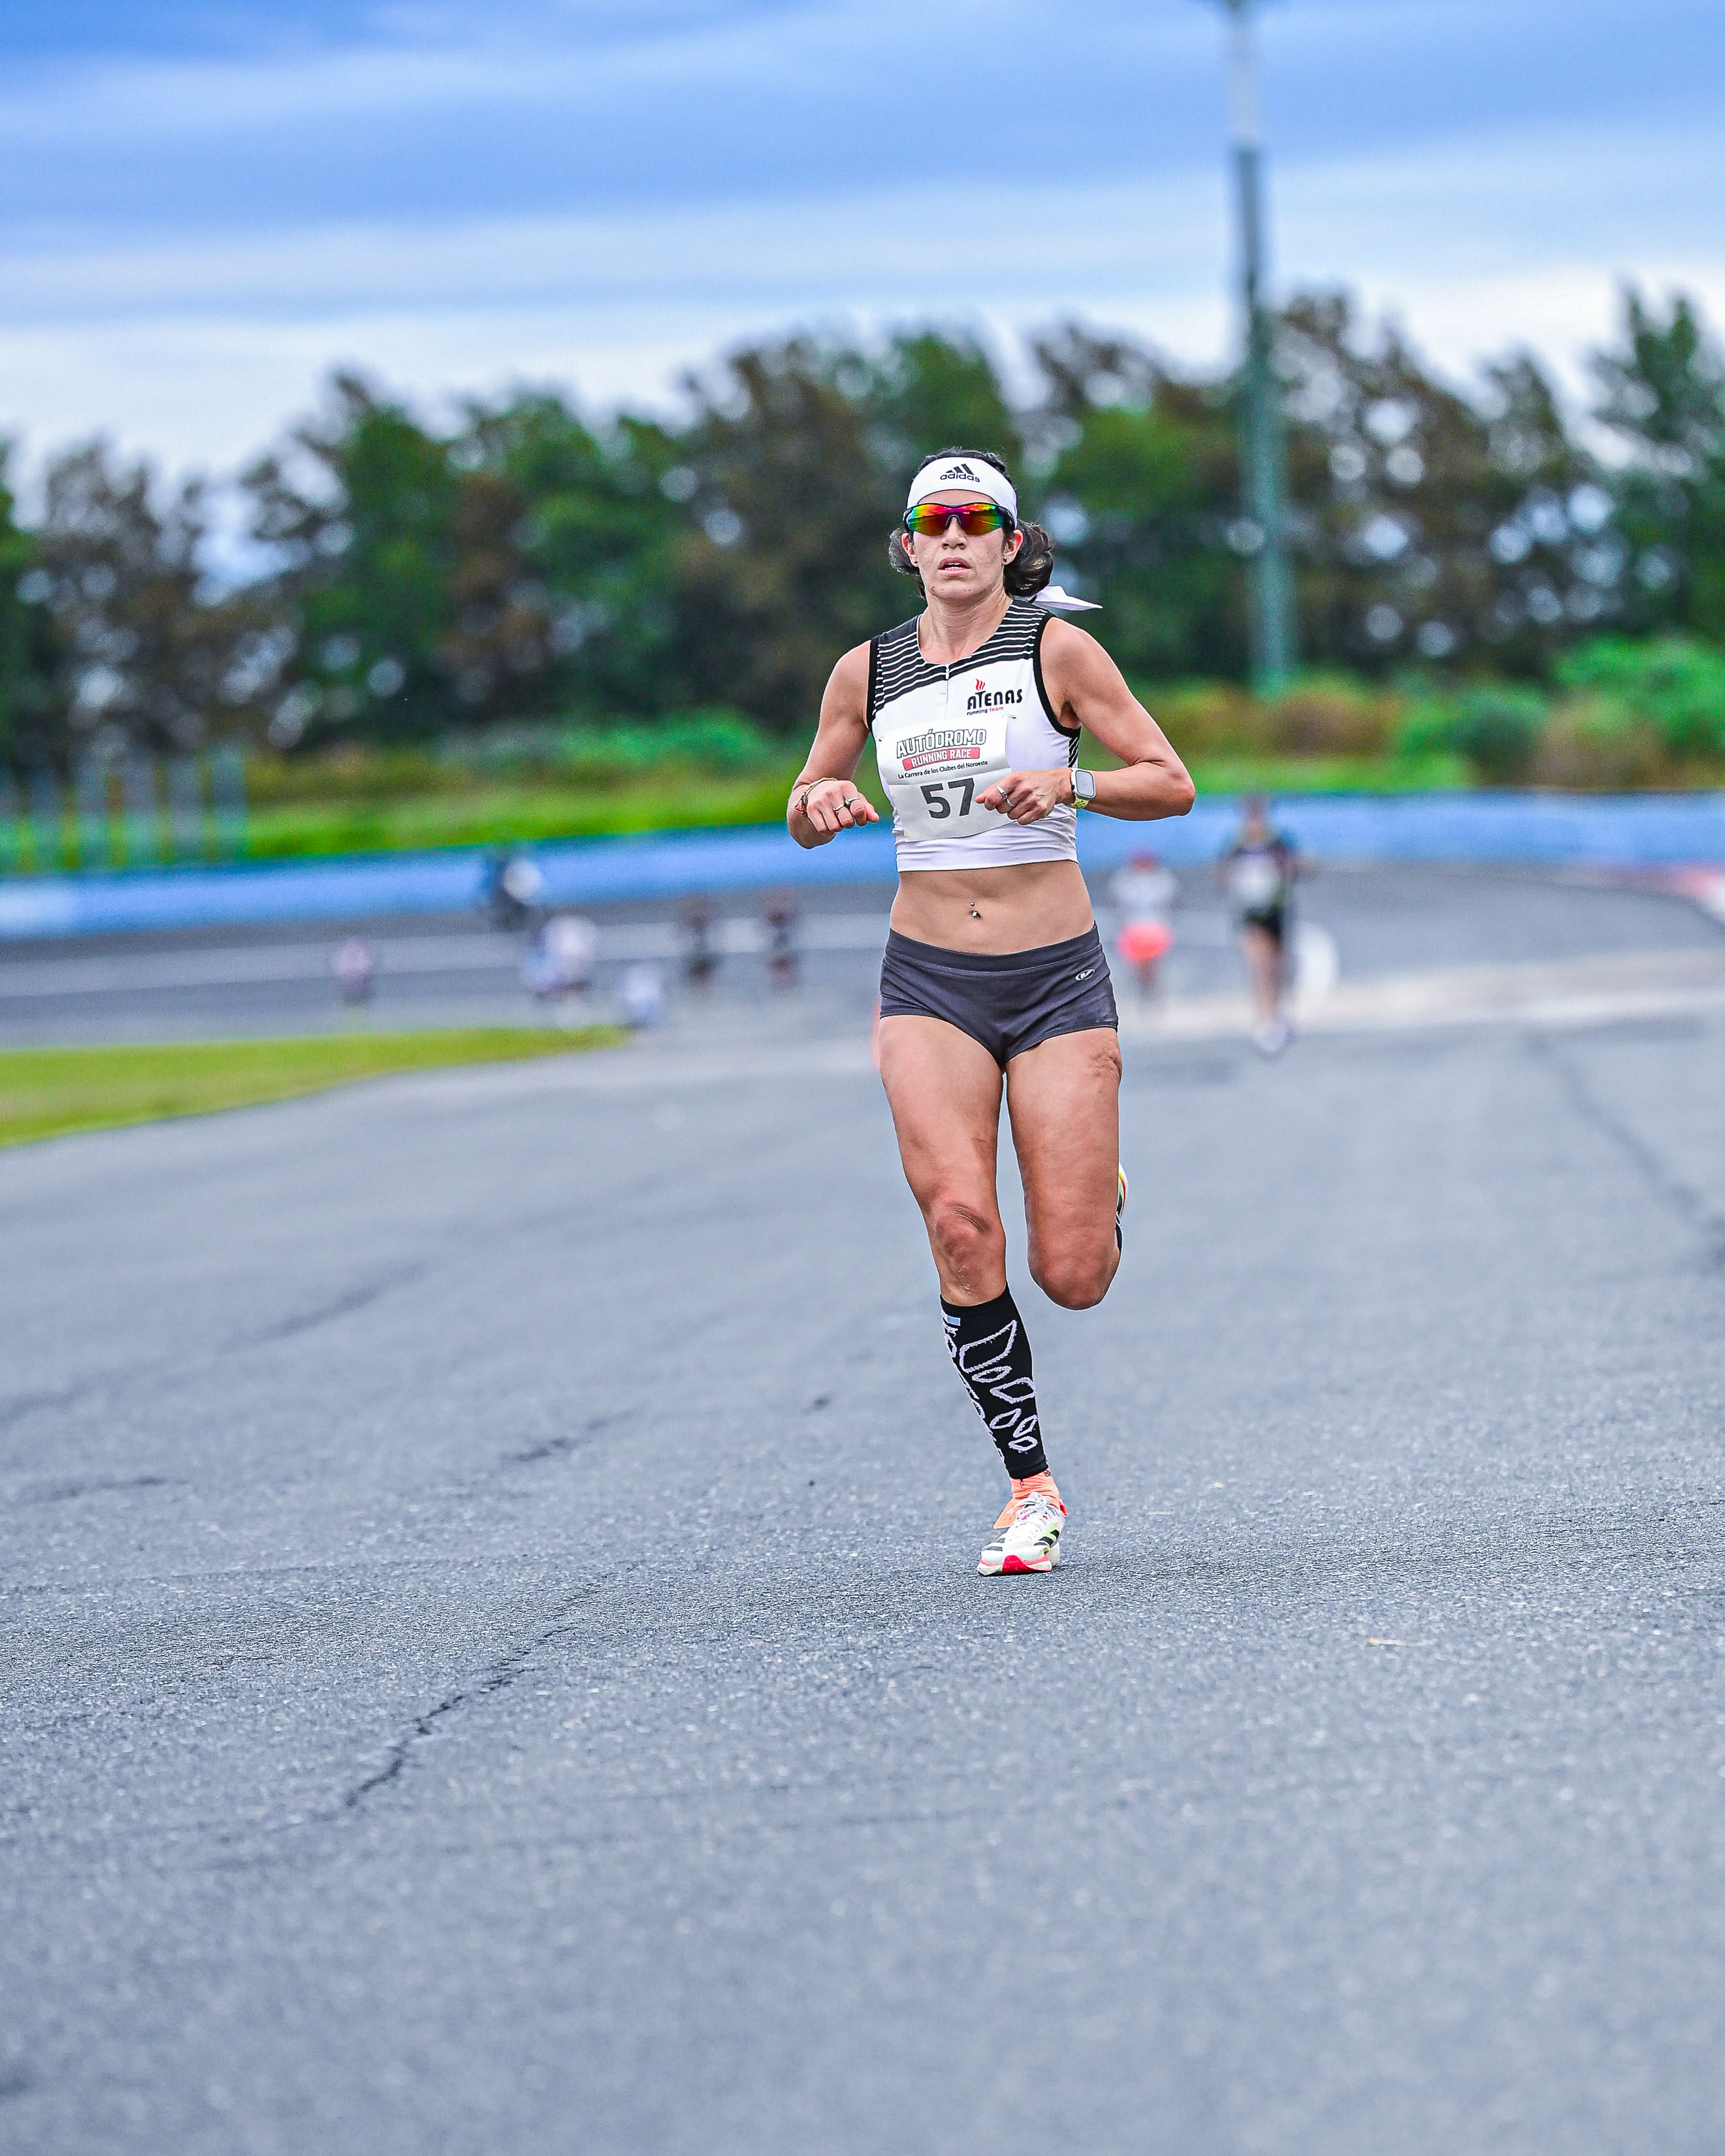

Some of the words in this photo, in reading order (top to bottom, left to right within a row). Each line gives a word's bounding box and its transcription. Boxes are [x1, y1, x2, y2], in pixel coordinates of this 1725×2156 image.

[940, 472, 980, 483] adidas
[967, 688, 1023, 710] ATENAS
[896, 728, 987, 759] AUTÓDROMO
[910, 750, 948, 768] RUNNING
[950, 748, 971, 759] RACE
[920, 777, 975, 819] 57
